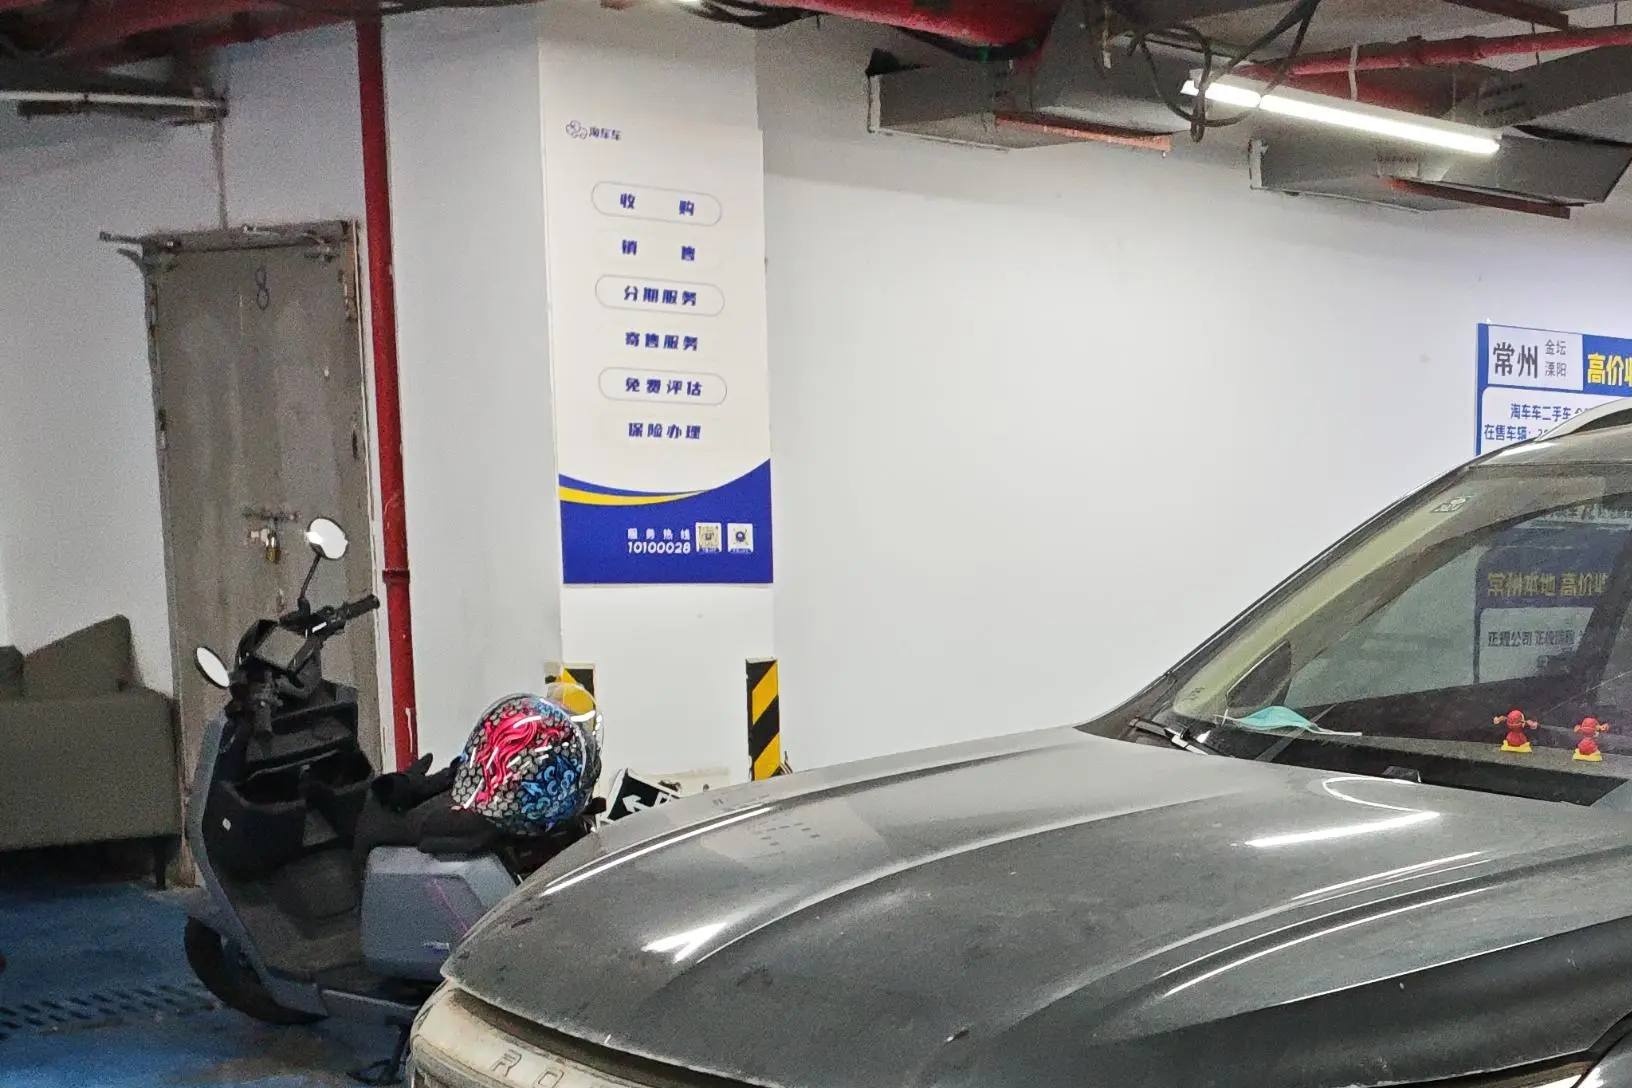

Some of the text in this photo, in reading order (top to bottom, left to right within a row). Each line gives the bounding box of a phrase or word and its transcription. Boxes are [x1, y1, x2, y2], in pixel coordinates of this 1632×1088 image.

[589, 126, 622, 140] 淘车车
[619, 193, 695, 216] 收购
[621, 239, 696, 261] 销售
[624, 285, 697, 306] 分期服务
[625, 331, 698, 351] 寄售服务
[1545, 339, 1567, 356] 金坛
[1493, 341, 1538, 379] 常州
[1545, 361, 1567, 377] 溧阳
[625, 377, 702, 396] 免费评估
[1510, 403, 1572, 422] 淘车车二手车
[628, 422, 701, 439] 保险办理
[628, 541, 691, 554] 10100028
